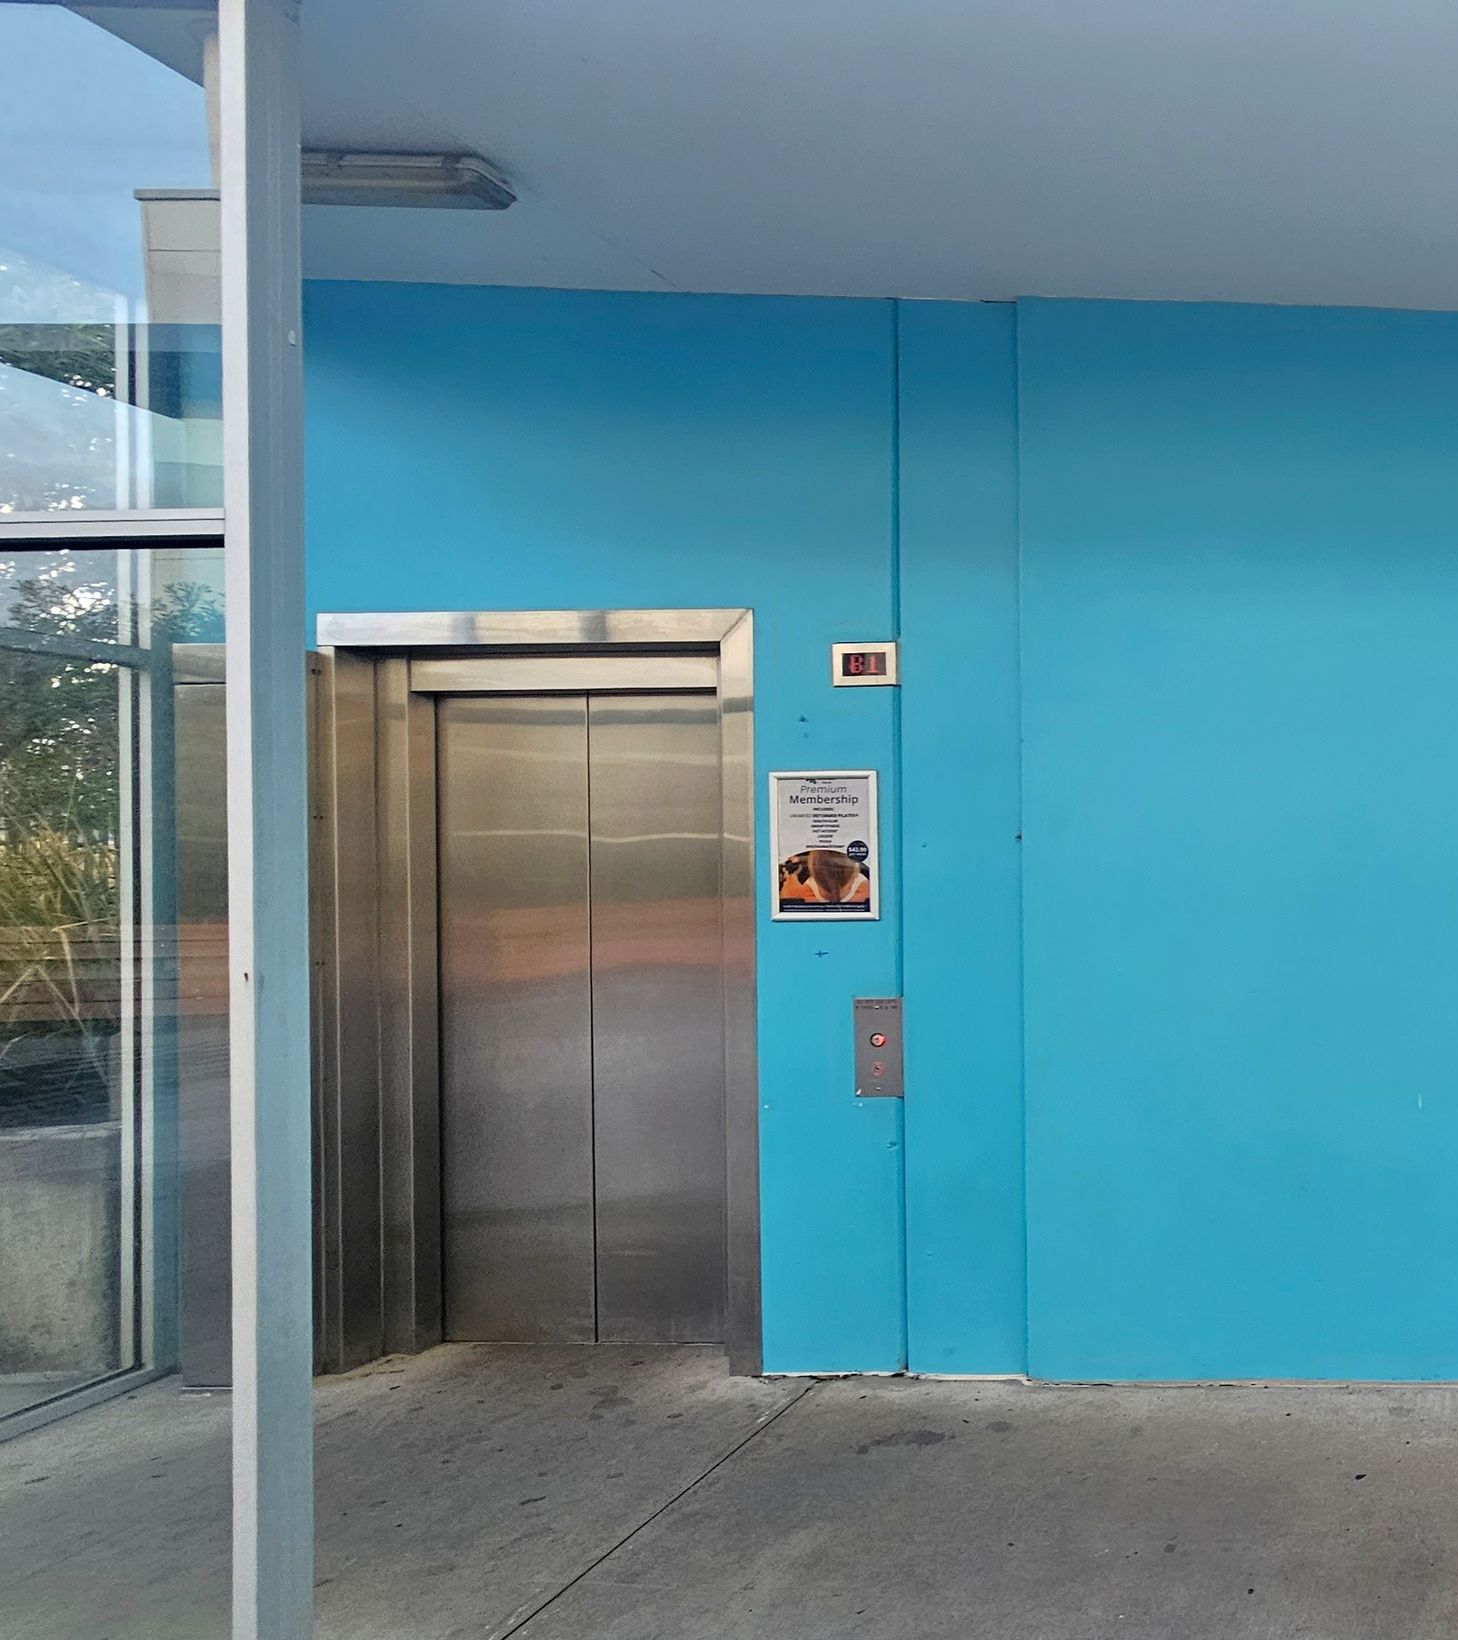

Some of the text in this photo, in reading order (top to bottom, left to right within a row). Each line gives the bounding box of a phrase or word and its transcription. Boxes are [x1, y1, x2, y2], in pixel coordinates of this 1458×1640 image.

[849, 655, 878, 674] B1
[800, 785, 847, 793] Premium
[789, 795, 859, 805] Membership
